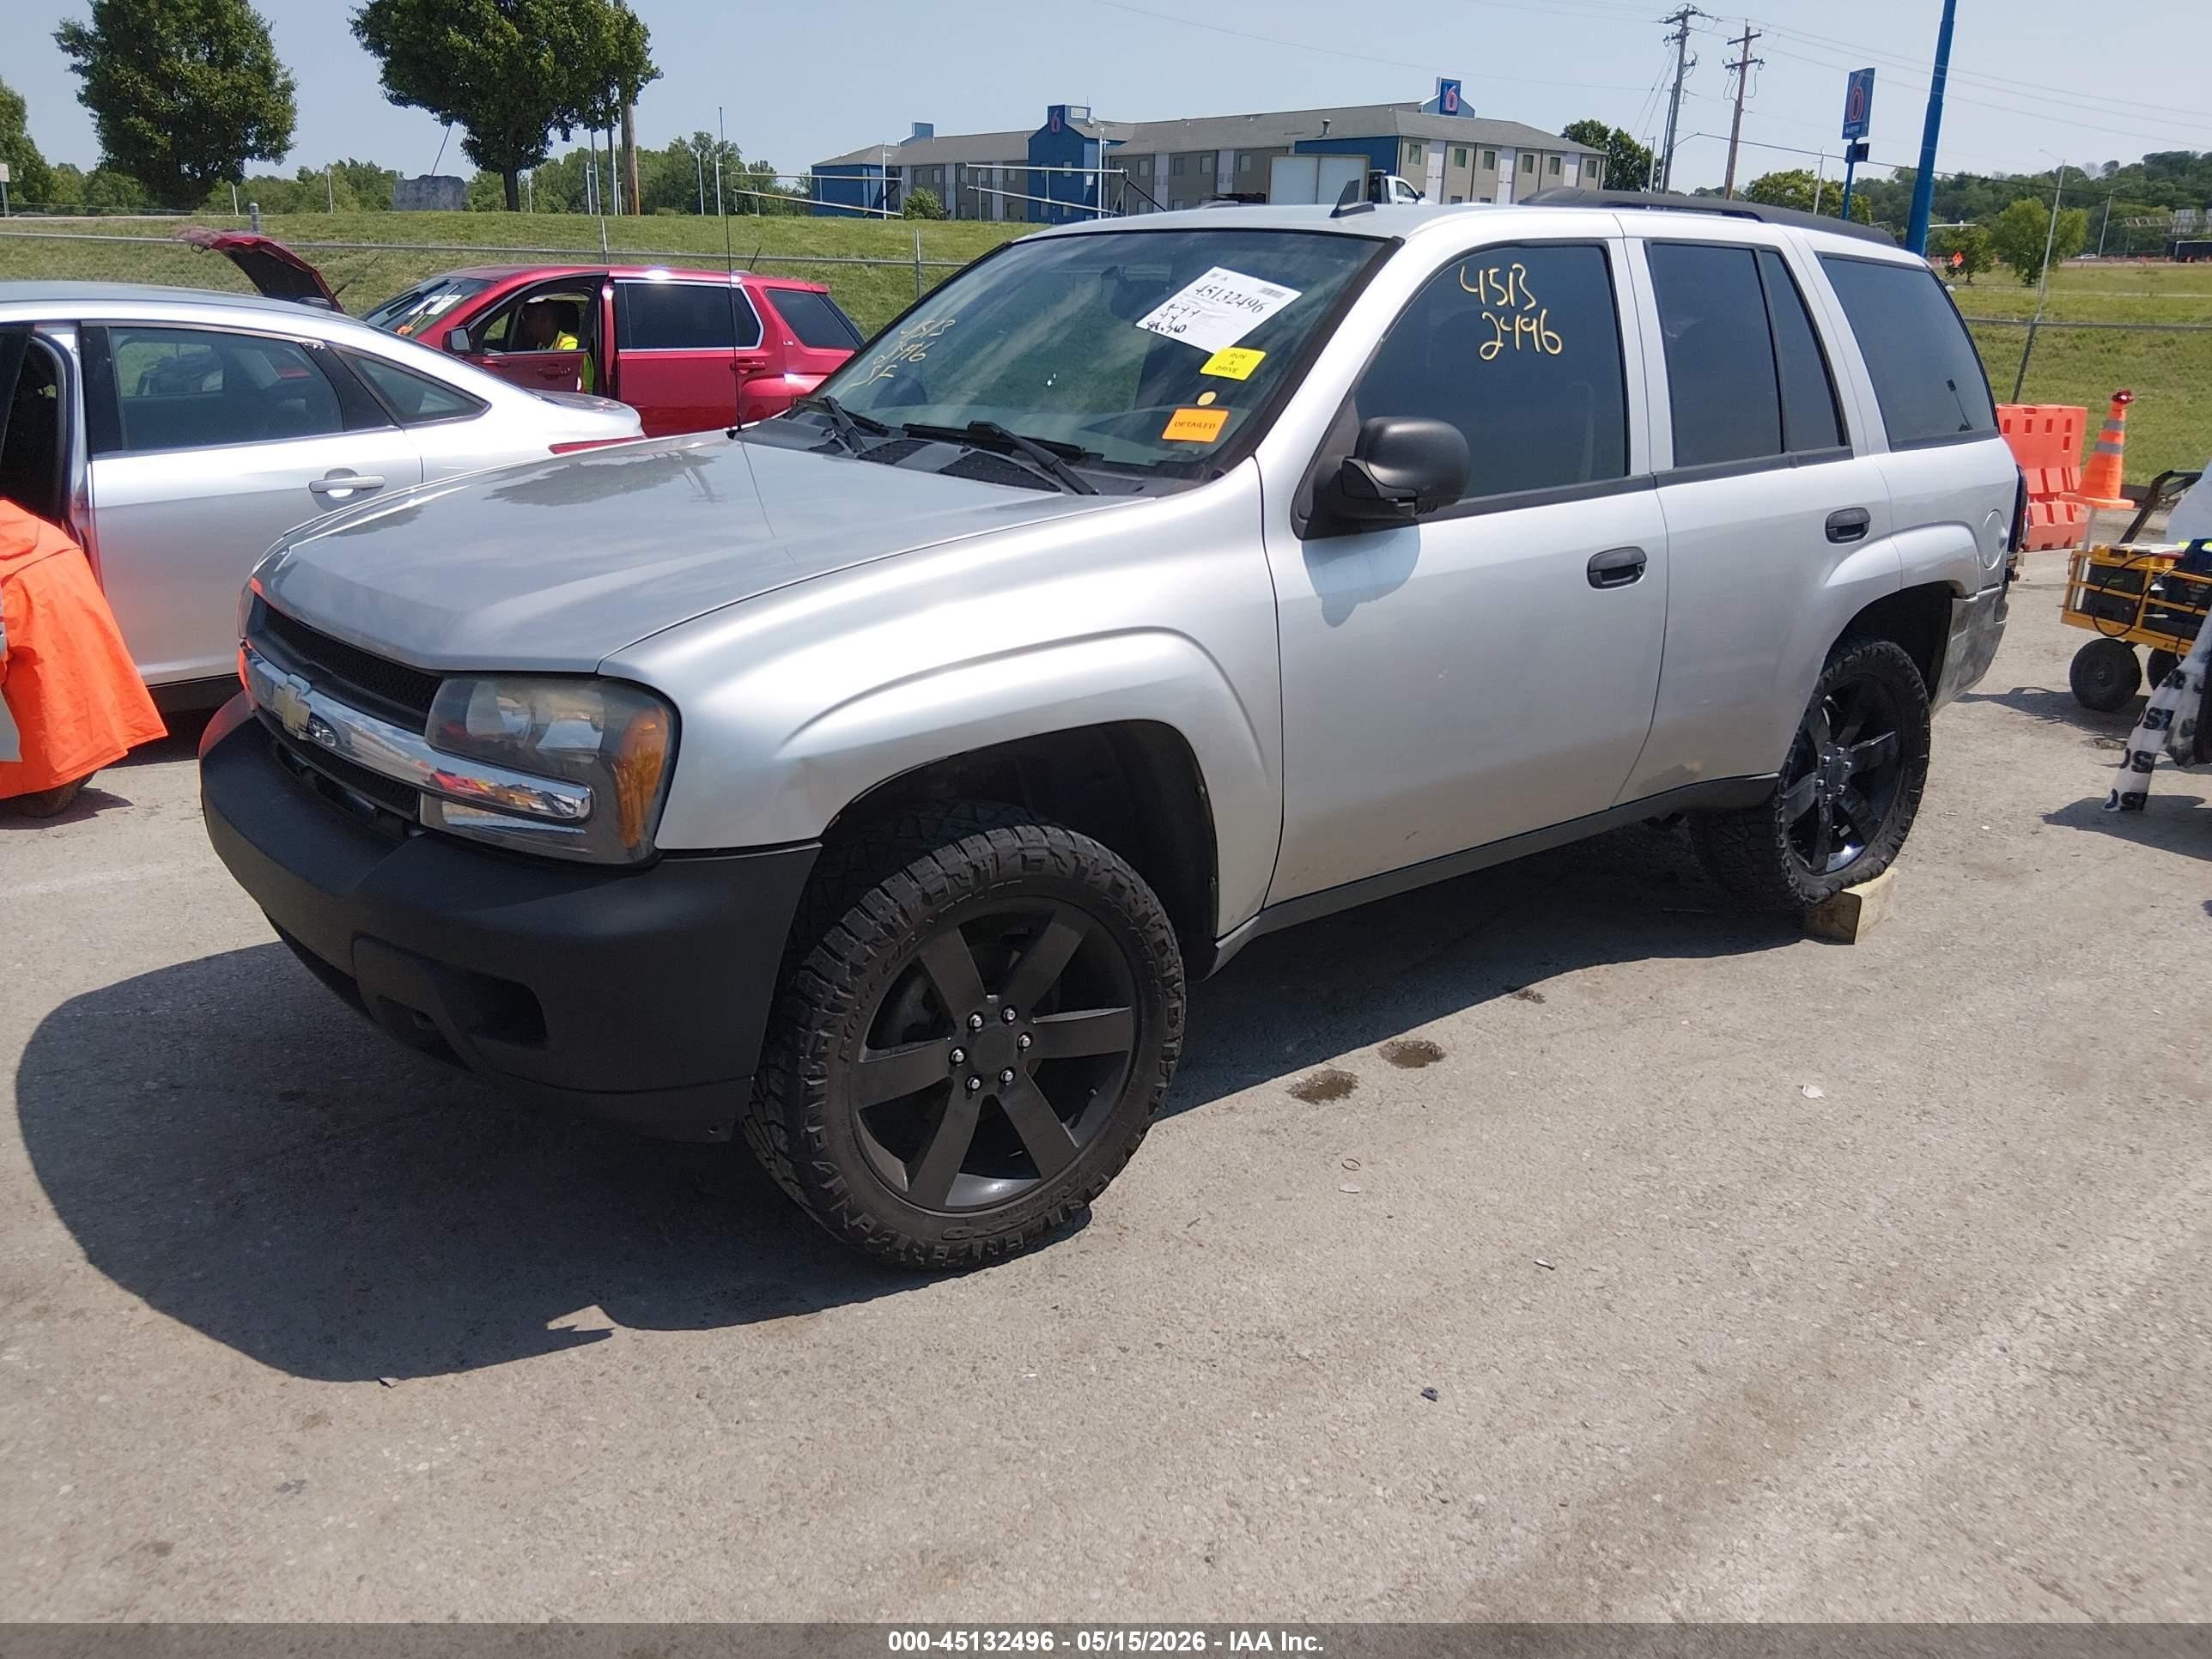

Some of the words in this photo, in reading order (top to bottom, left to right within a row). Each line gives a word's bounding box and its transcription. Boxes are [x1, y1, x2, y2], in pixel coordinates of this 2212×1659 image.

[1445, 85, 1457, 112] 6
[1050, 109, 1060, 132] 6
[1195, 284, 1271, 314] 45132496
[1479, 308, 1564, 362] 2496
[1174, 421, 1216, 429] DETAILED
